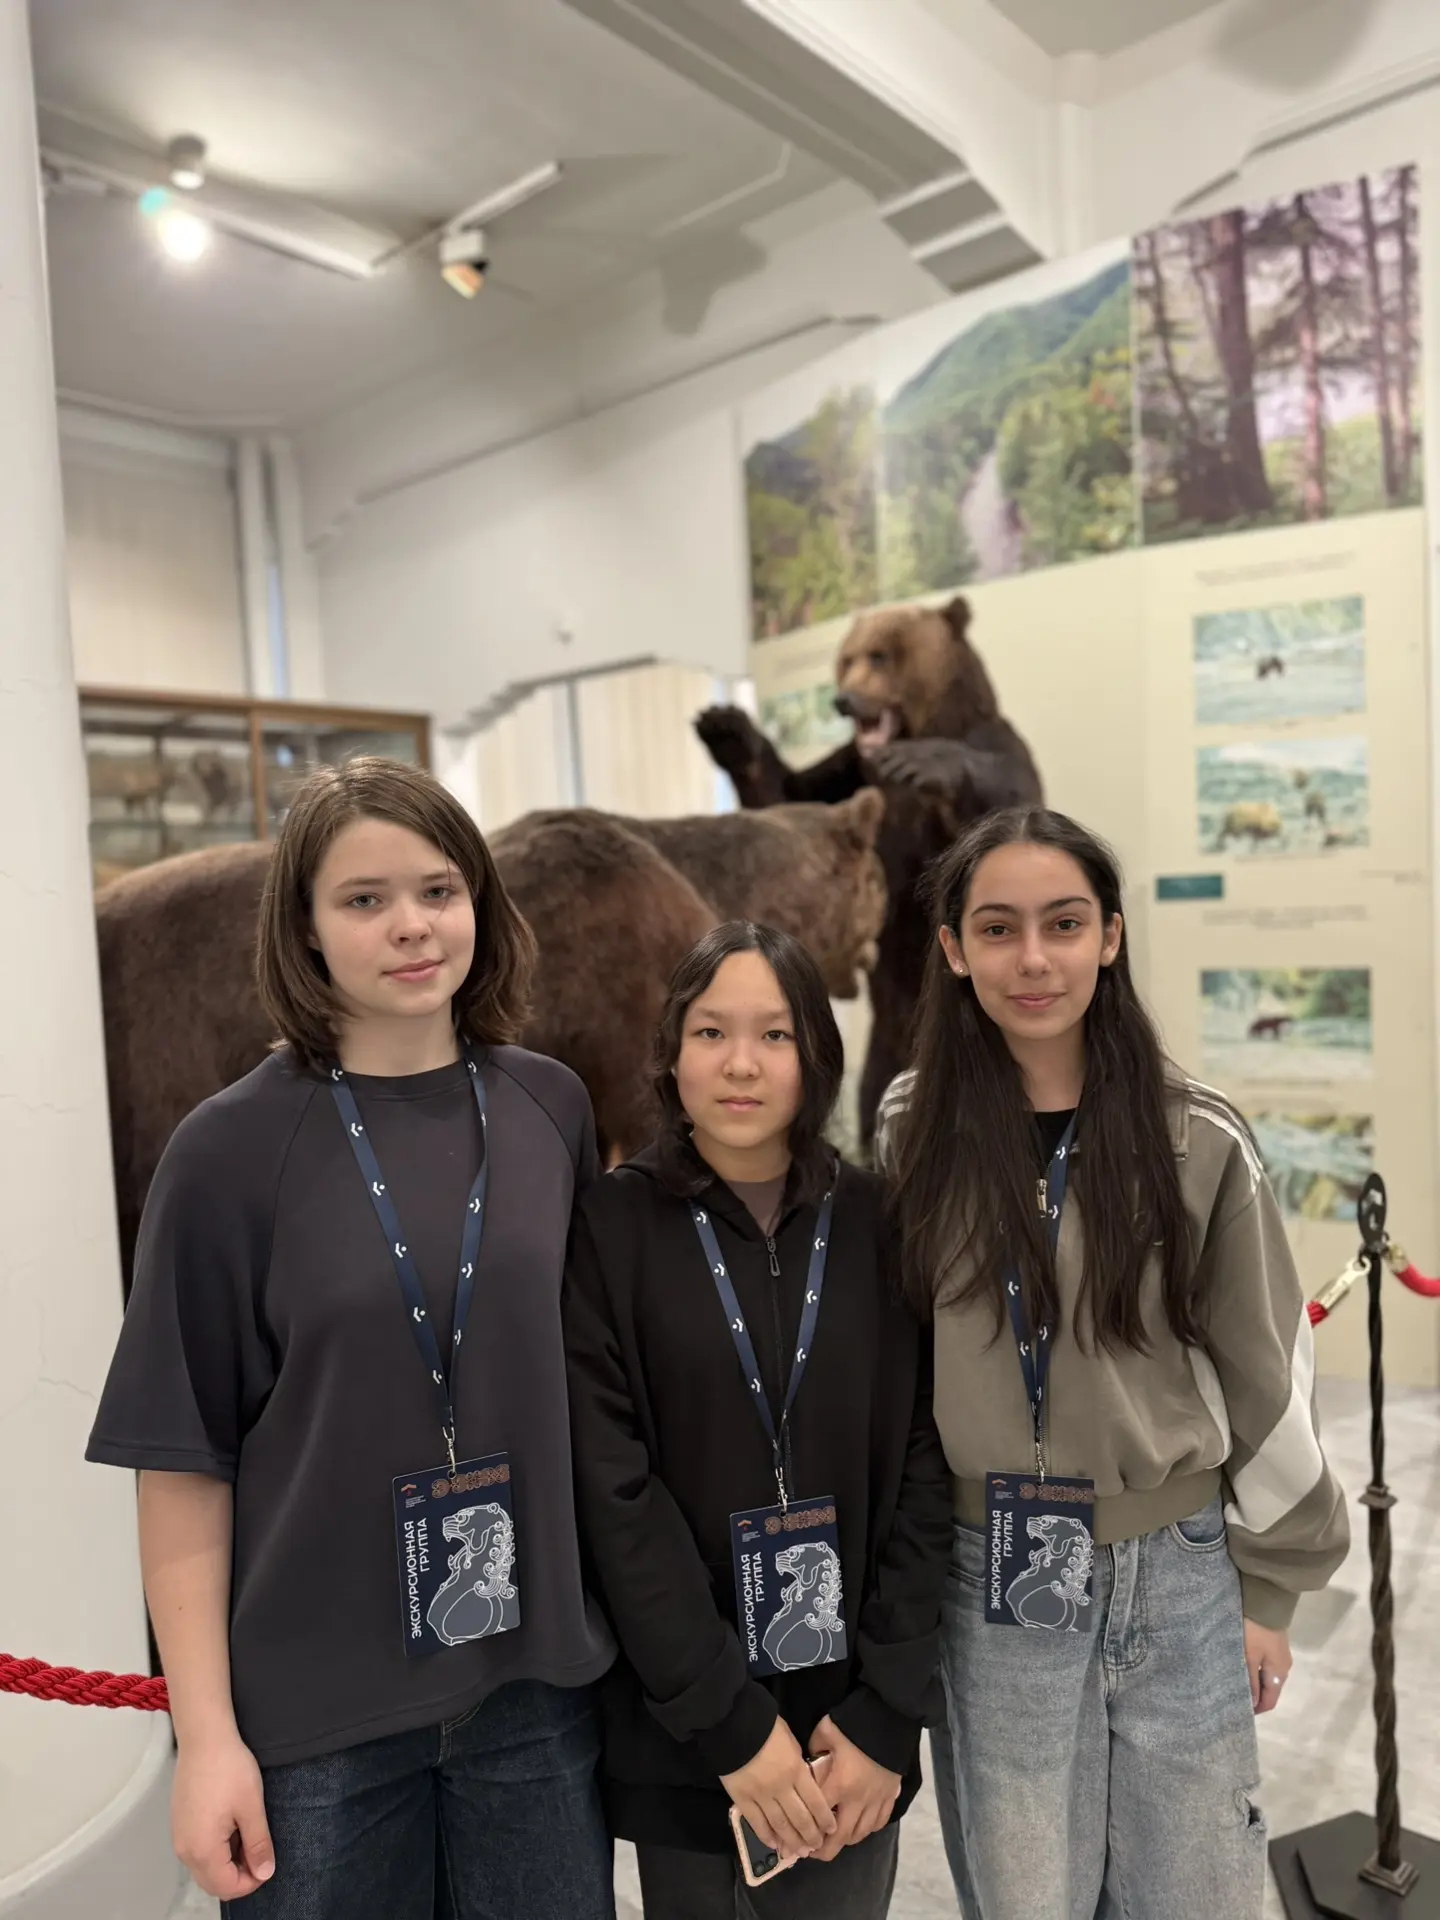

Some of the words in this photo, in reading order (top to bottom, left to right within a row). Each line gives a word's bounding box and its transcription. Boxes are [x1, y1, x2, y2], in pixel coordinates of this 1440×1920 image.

[417, 1517, 430, 1572] ГРУППА
[991, 1510, 1002, 1610] ЭКСКУРСИОННАЯ
[1003, 1511, 1014, 1557] ГРУППА
[404, 1521, 422, 1639] ЭКСКУРСИОННАЯ
[741, 1554, 758, 1662] ЭКСКУРСИОННАЯ
[753, 1551, 765, 1602] ГРУППА
